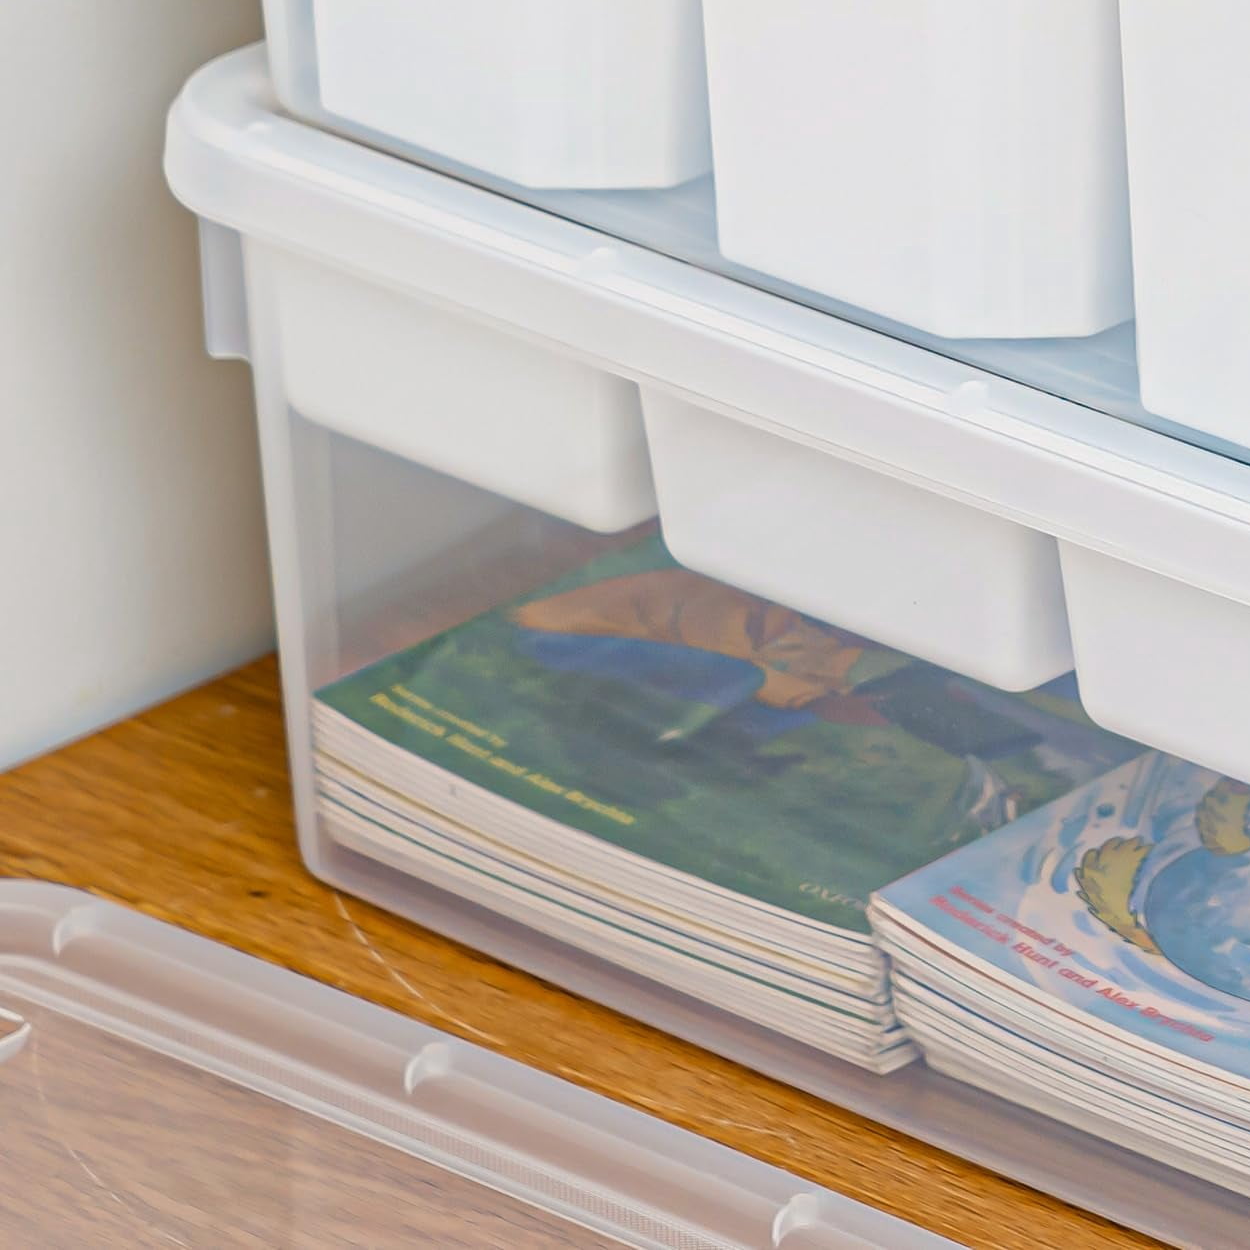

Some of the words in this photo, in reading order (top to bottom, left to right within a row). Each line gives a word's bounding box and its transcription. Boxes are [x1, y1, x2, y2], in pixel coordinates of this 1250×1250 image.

[1012, 942, 1059, 969] Hunt
[1057, 968, 1098, 988] and
[1096, 987, 1139, 1010] Alex
